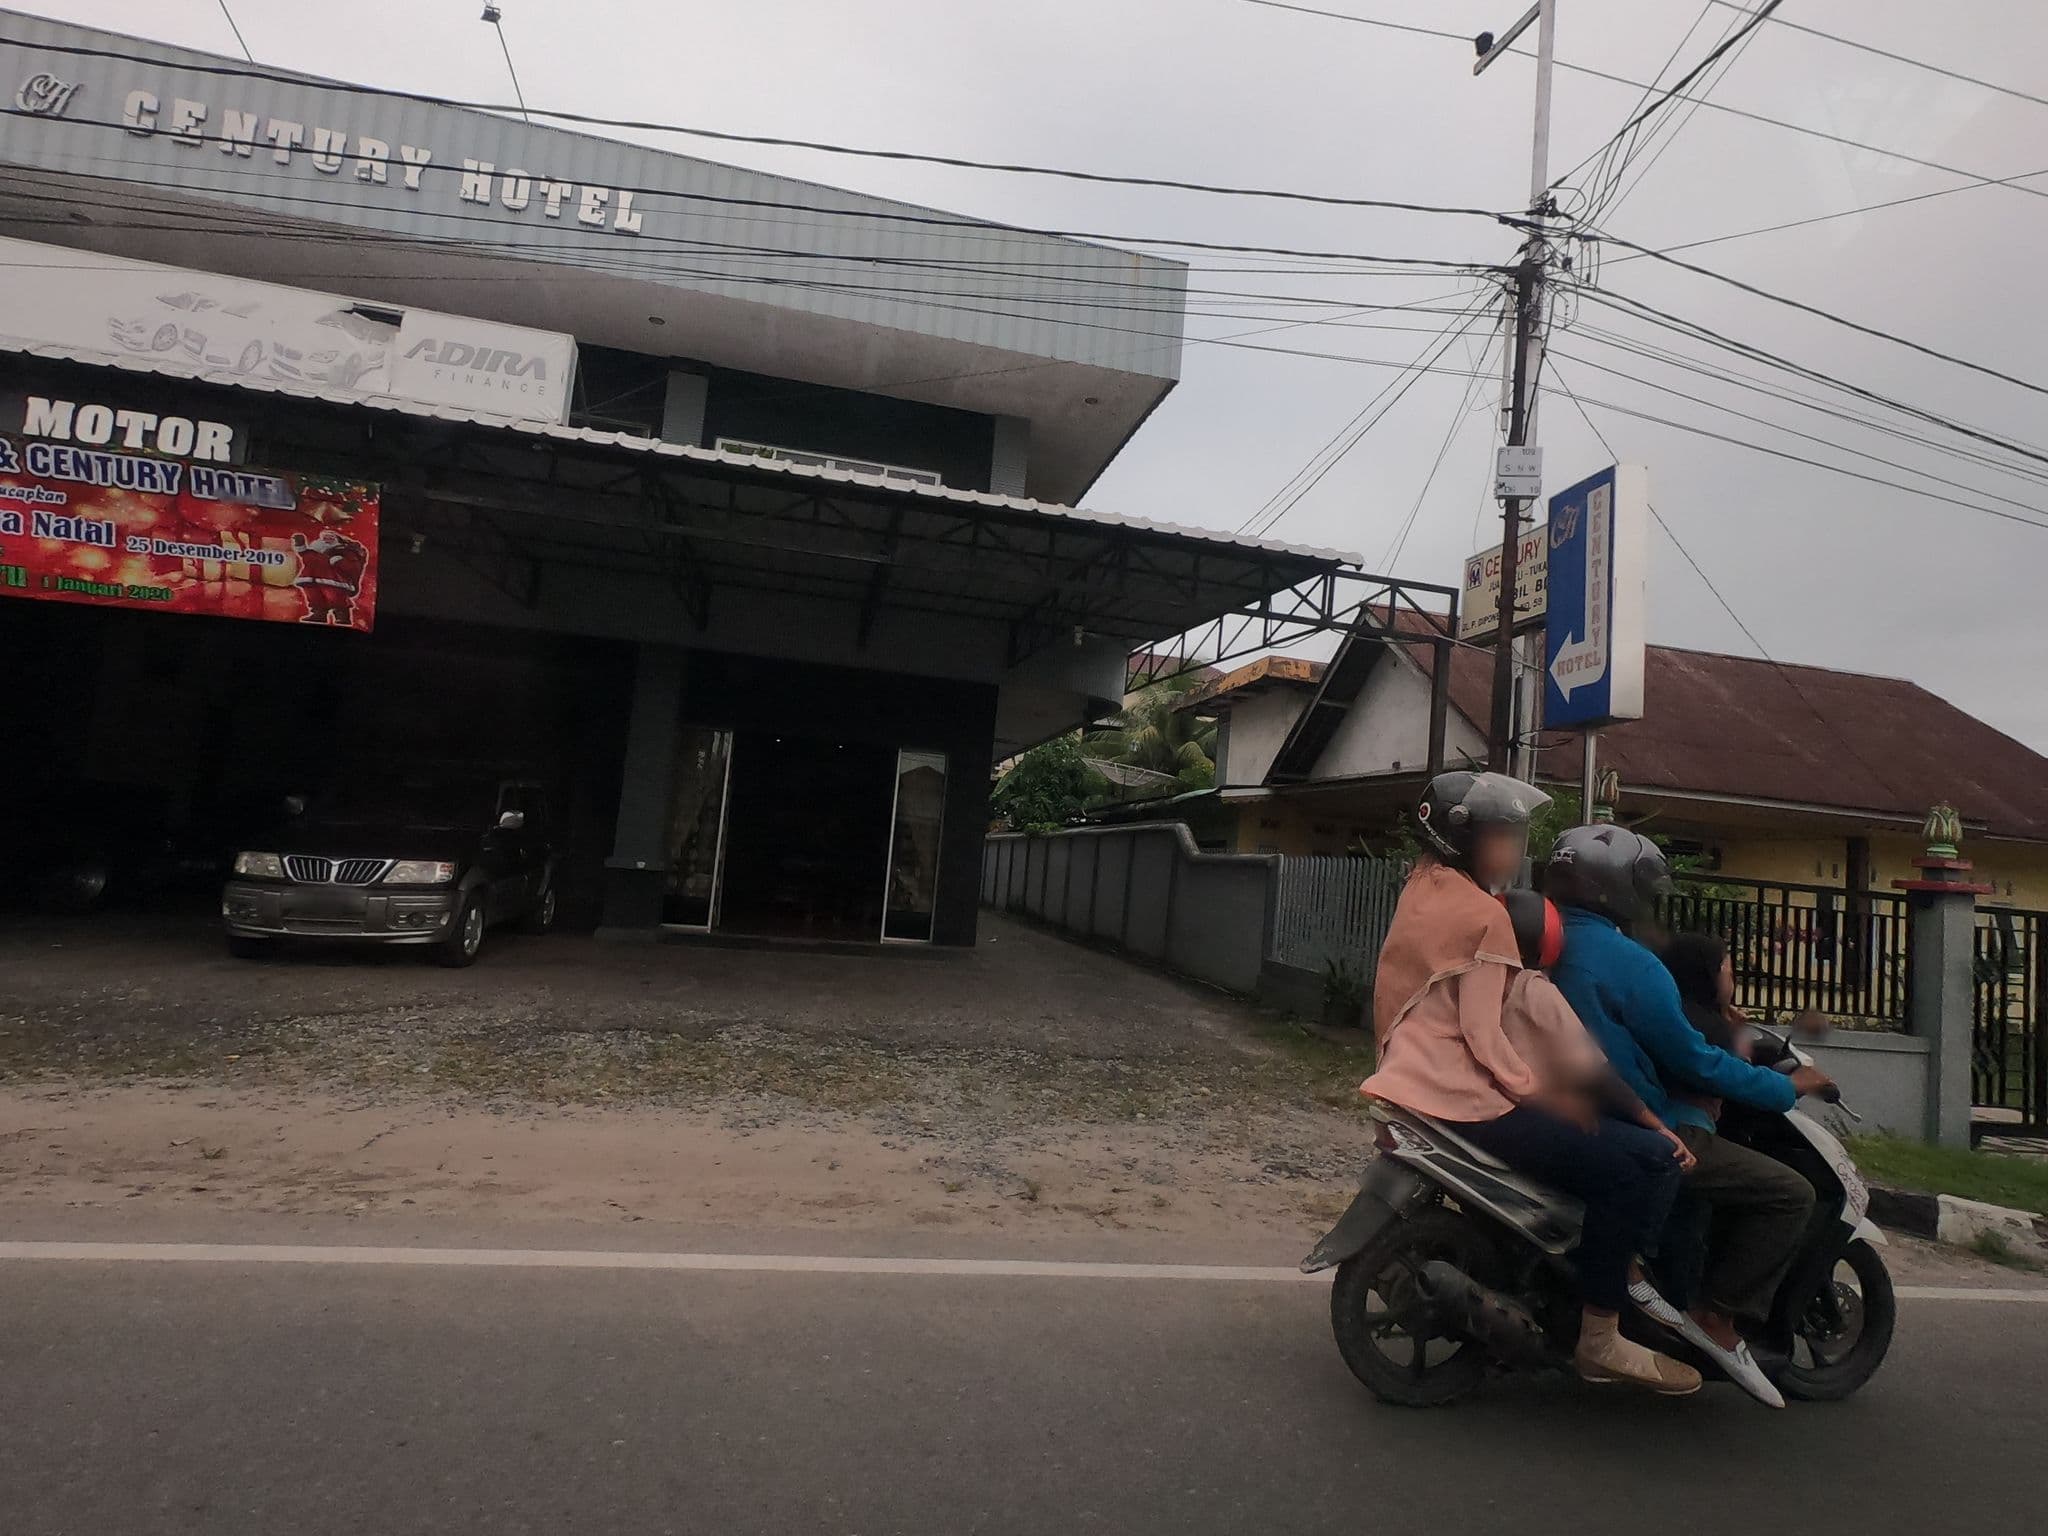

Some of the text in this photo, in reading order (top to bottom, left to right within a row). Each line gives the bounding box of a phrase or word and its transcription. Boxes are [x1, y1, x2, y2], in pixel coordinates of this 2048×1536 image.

[122, 89, 644, 234] CENTURY HOTEL
[403, 338, 546, 381] ADIRA
[433, 369, 545, 396] FINANCE
[23, 396, 234, 463] MOTOR
[26, 442, 183, 496] CENTURY
[31, 510, 116, 547] Natal
[126, 536, 285, 566] 25 Desember 2019
[1484, 537, 1542, 578] CEURY
[1591, 490, 1602, 648] CENTURY
[1556, 651, 1601, 678] HOTEL
